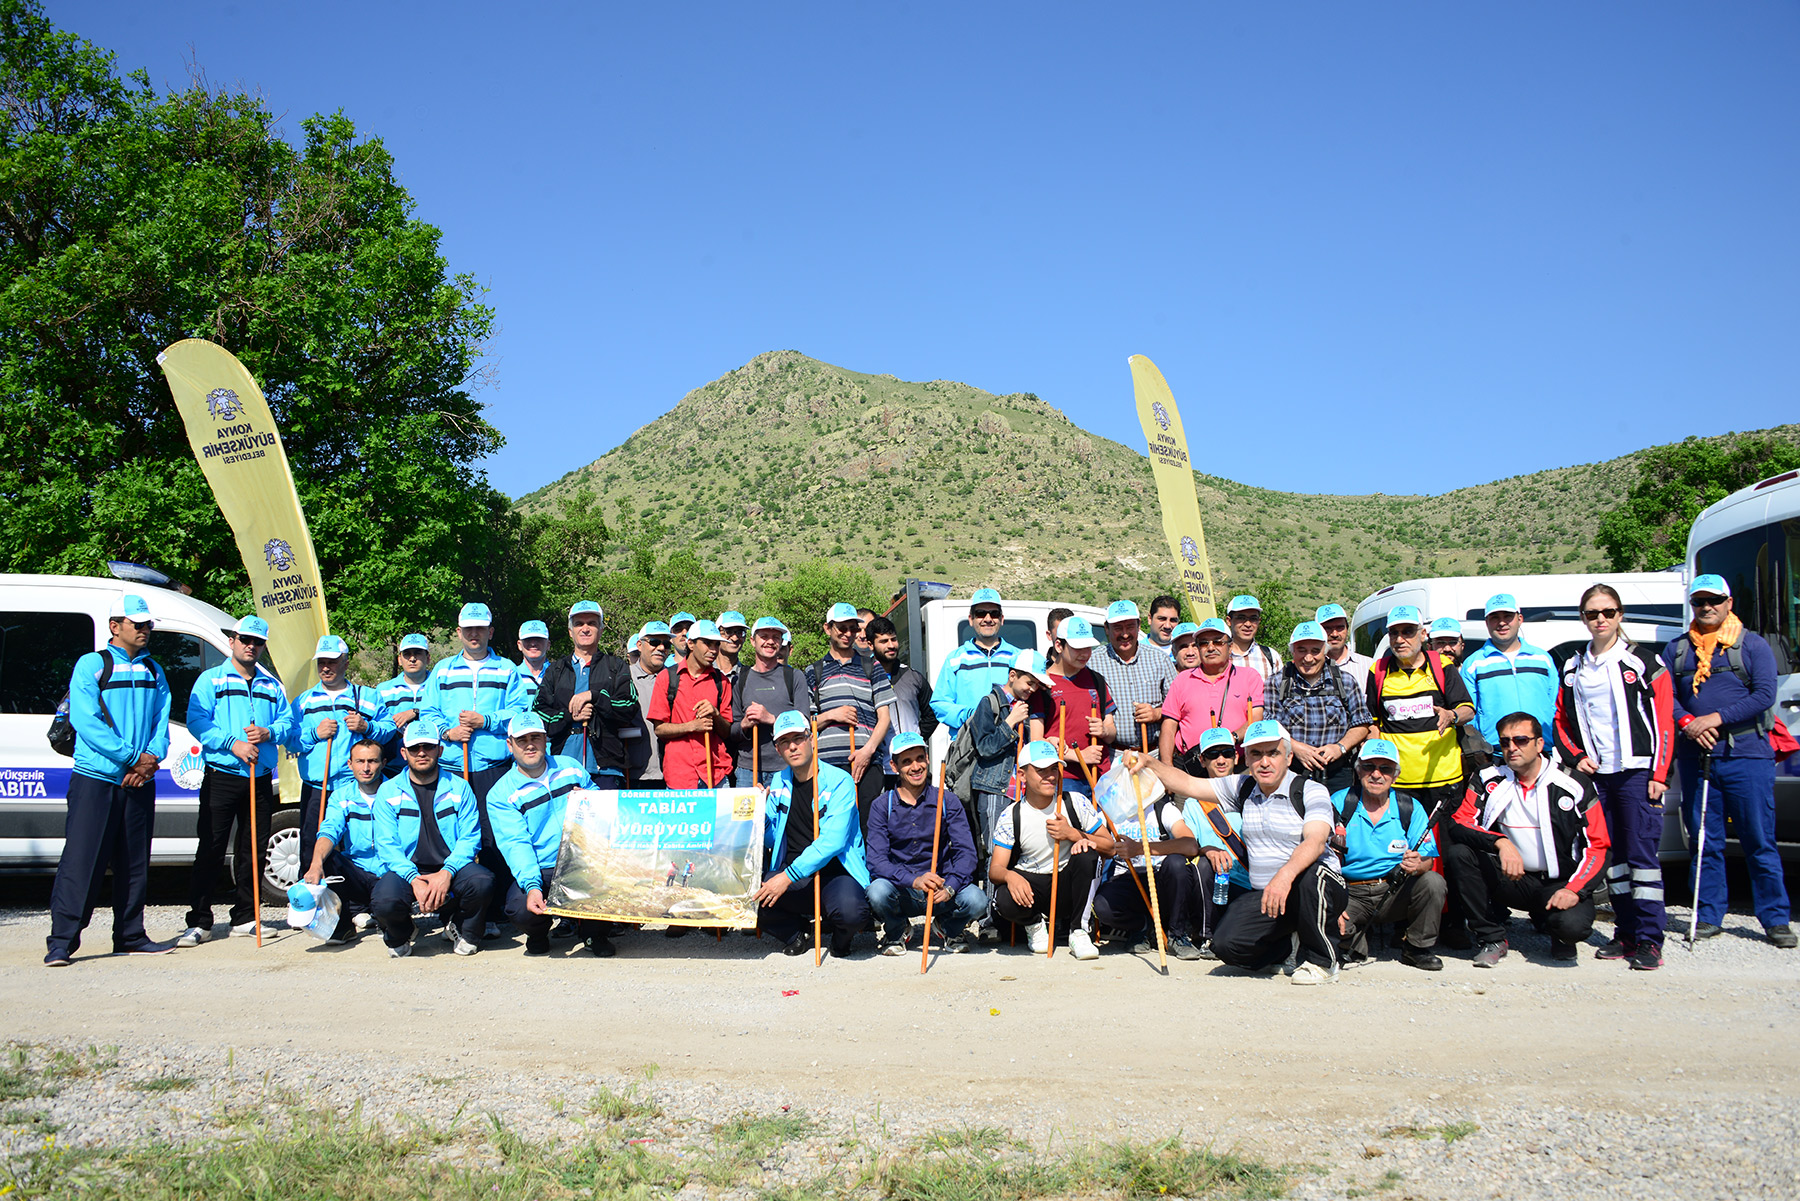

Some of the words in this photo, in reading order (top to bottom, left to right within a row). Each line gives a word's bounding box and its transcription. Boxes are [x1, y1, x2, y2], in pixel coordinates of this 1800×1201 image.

[621, 790, 651, 798] GÖRME
[638, 799, 698, 814] TABİAT
[619, 820, 712, 838] YÜRÜYÜŞÜ
